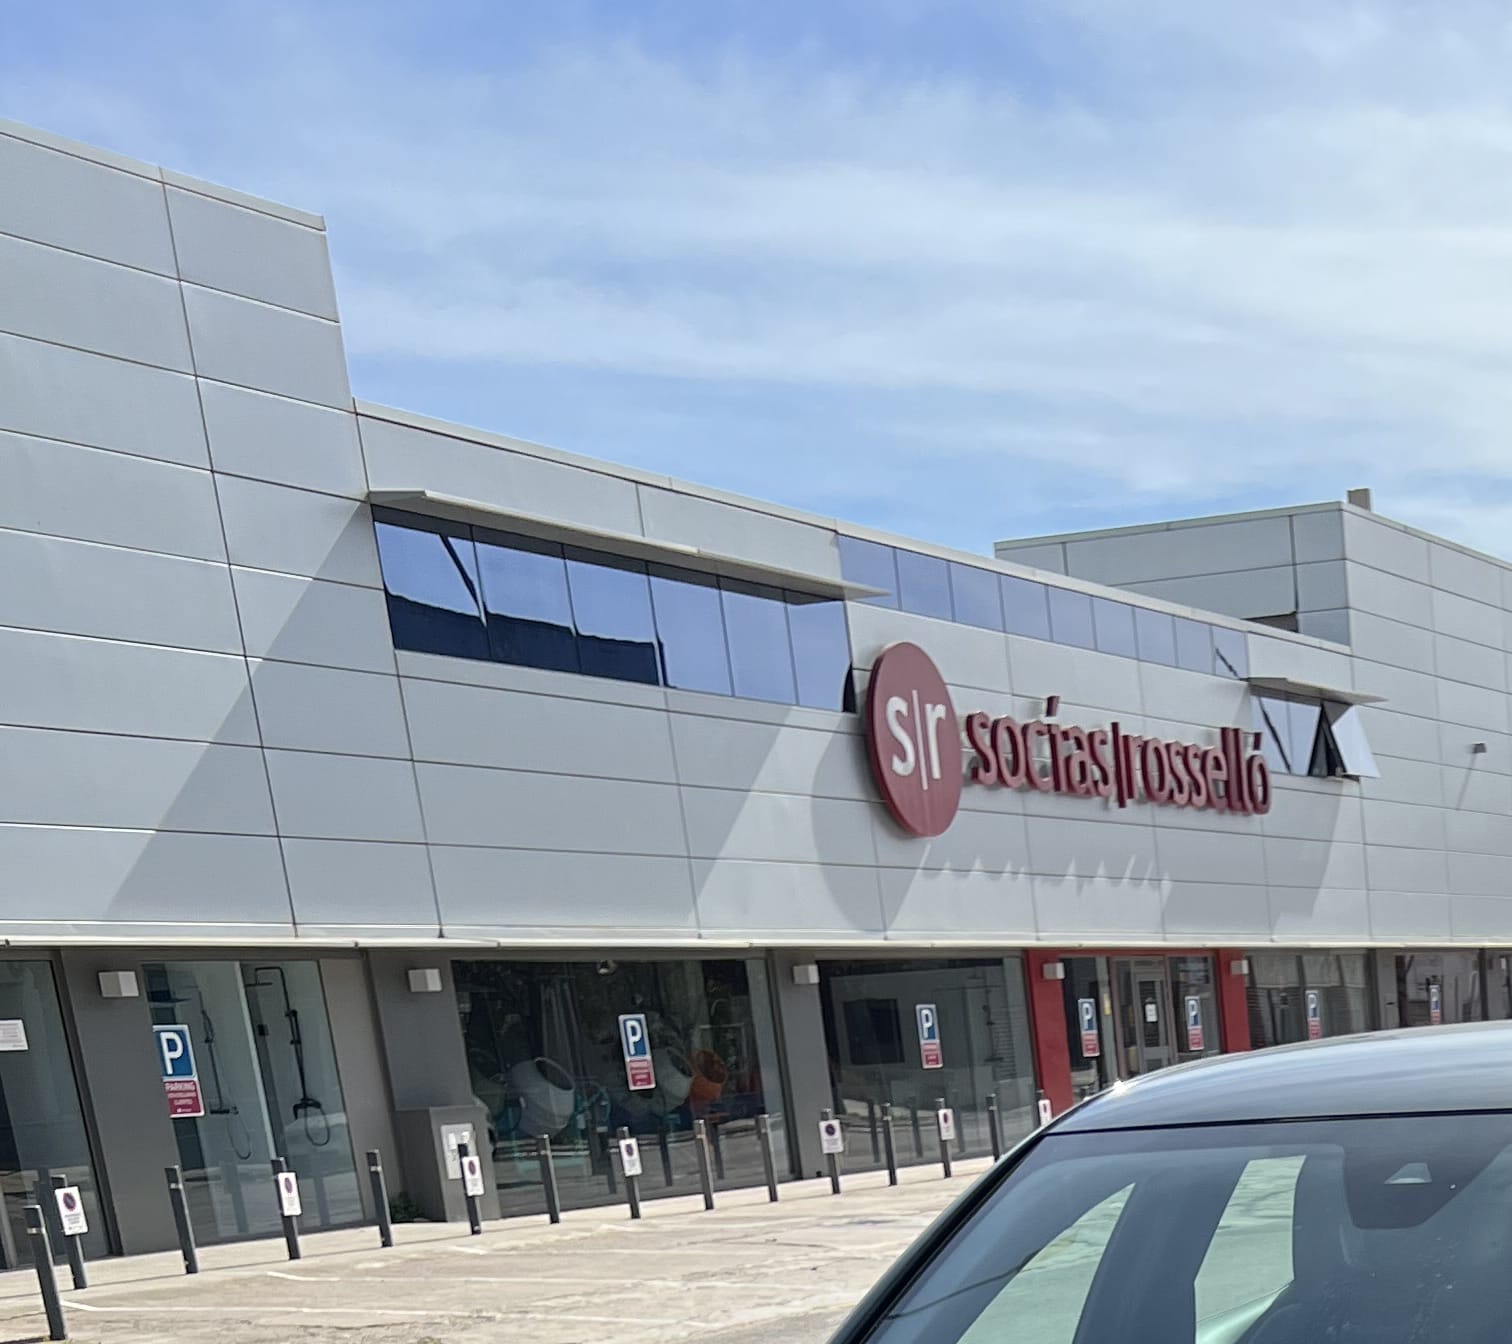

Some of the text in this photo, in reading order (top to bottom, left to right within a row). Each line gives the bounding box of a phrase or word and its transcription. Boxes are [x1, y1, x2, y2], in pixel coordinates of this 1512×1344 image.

[921, 1009, 933, 1039] P
[1082, 1003, 1093, 1030] P
[1188, 1001, 1198, 1027] P
[625, 1020, 642, 1055] P
[160, 1032, 184, 1075] P
